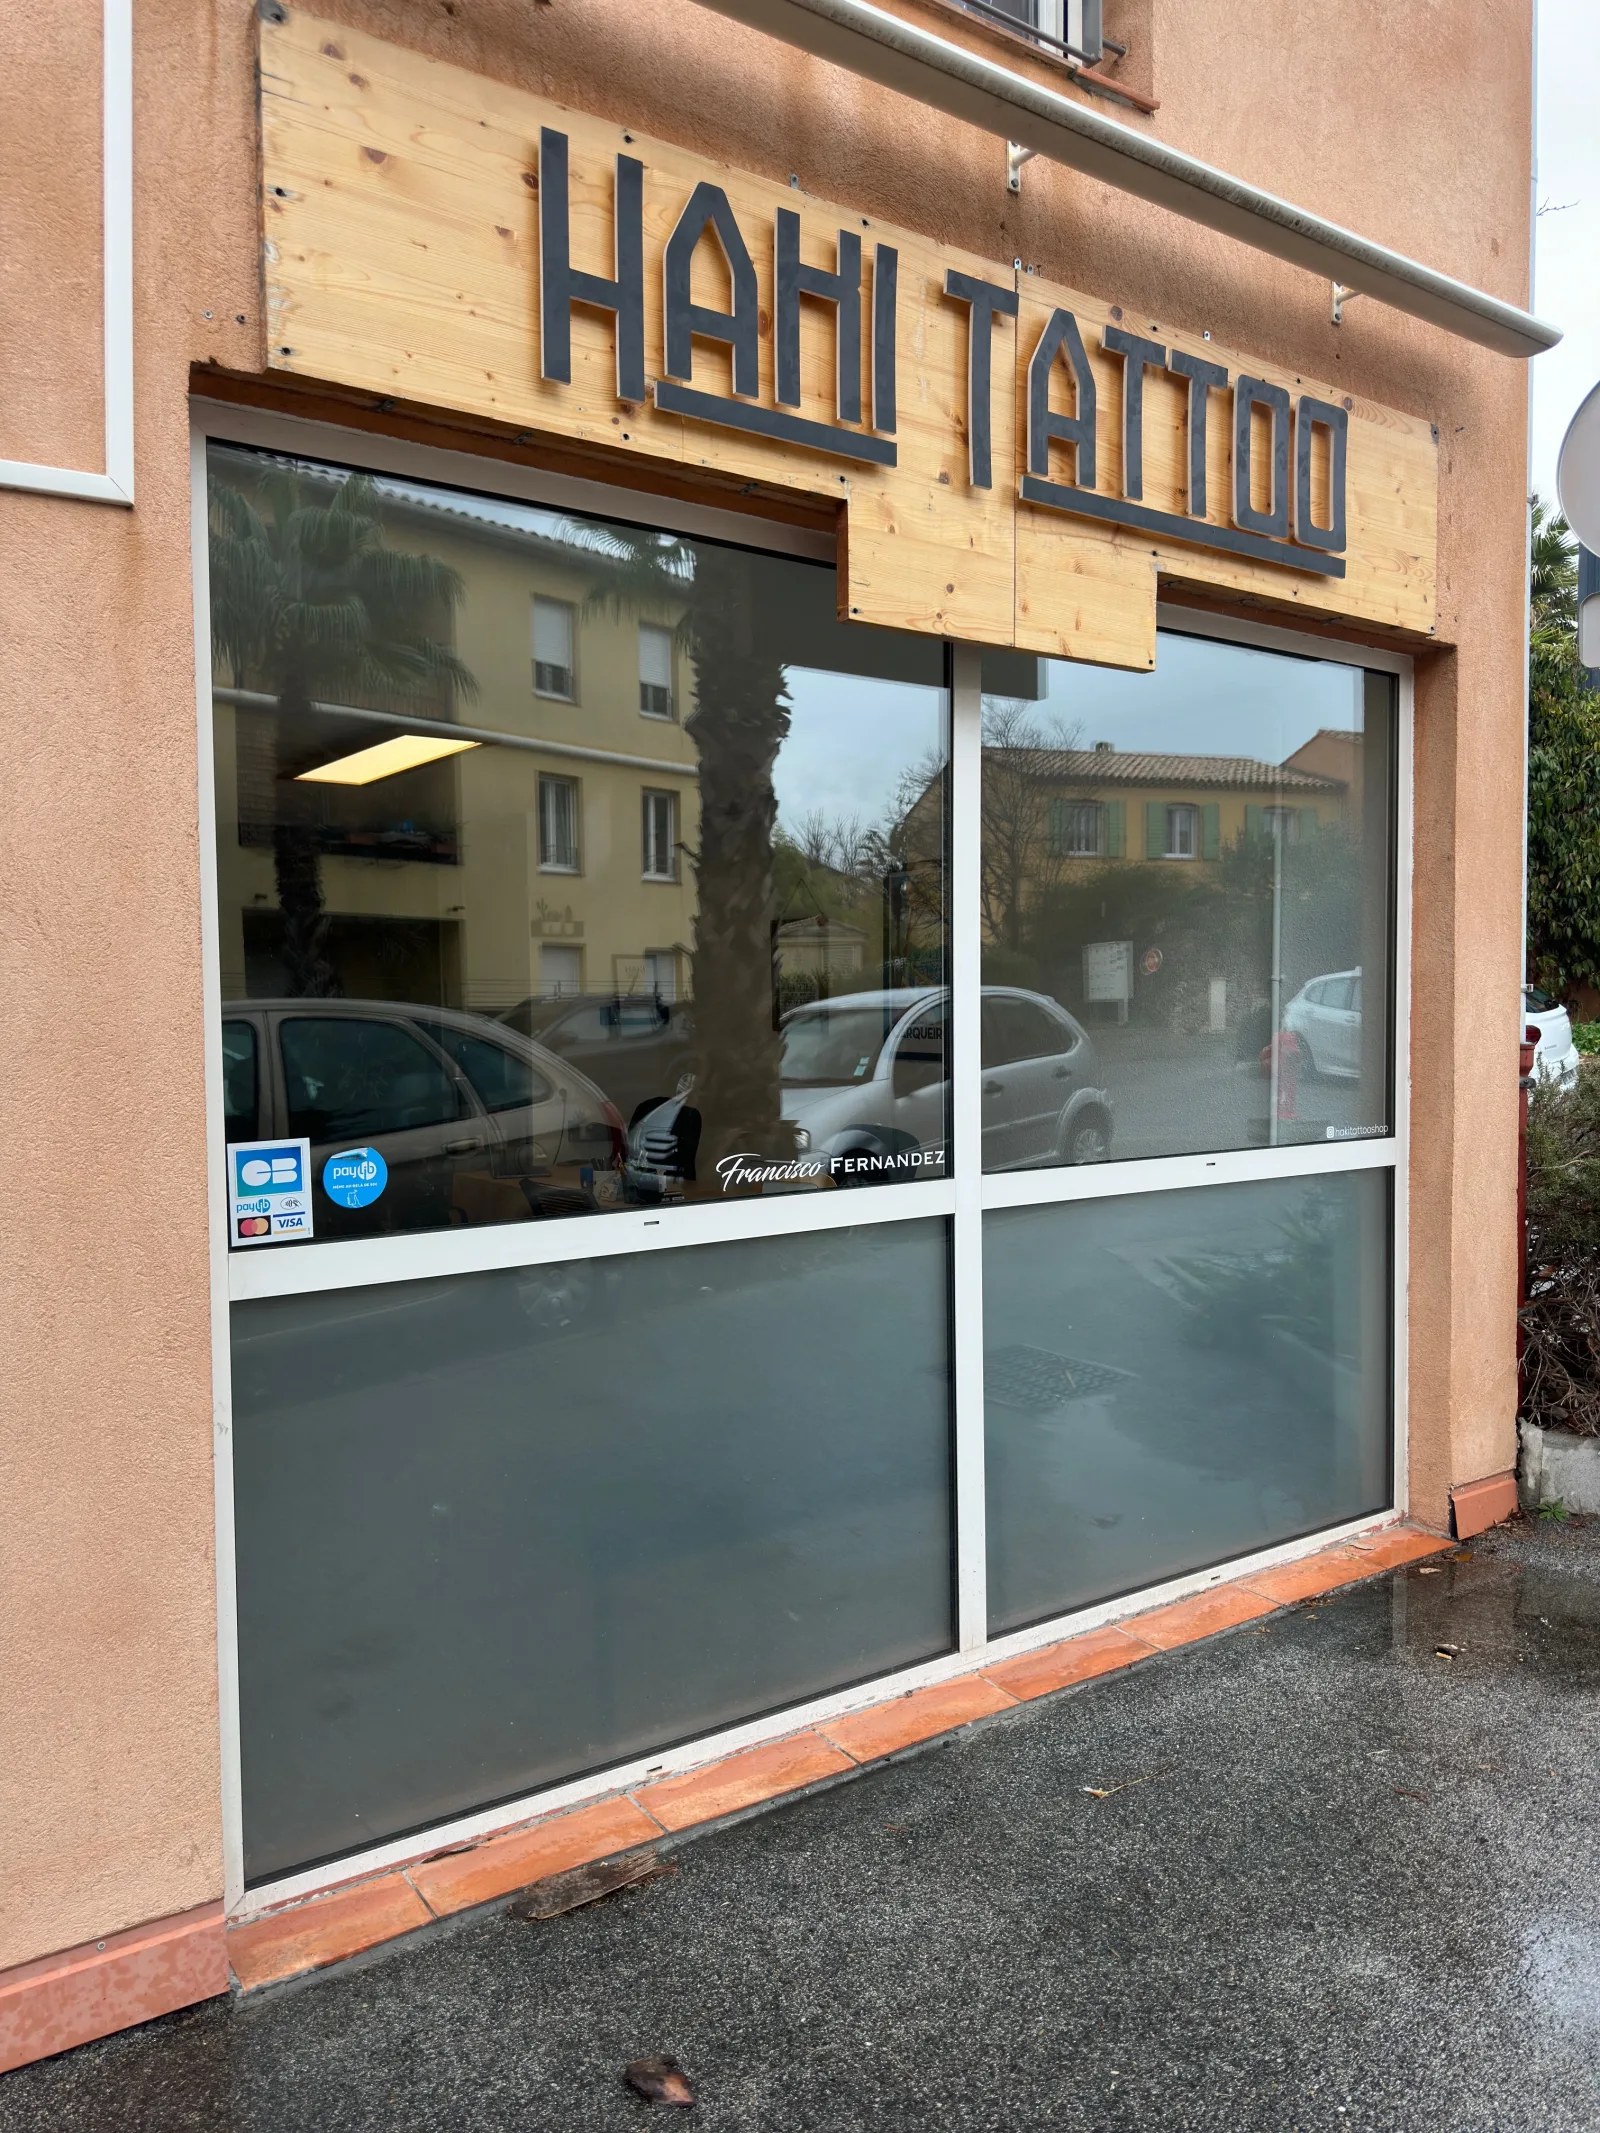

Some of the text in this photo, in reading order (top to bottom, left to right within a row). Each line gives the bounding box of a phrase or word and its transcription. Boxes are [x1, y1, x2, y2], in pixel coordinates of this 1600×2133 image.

[944, 268, 1349, 553] TATTOO
[241, 1157, 298, 1187] CB
[333, 1160, 377, 1181] paylib
[715, 1150, 945, 1192] Francisco FERNANDEZ
[236, 1198, 271, 1214] paylib
[277, 1217, 303, 1229] VISA
